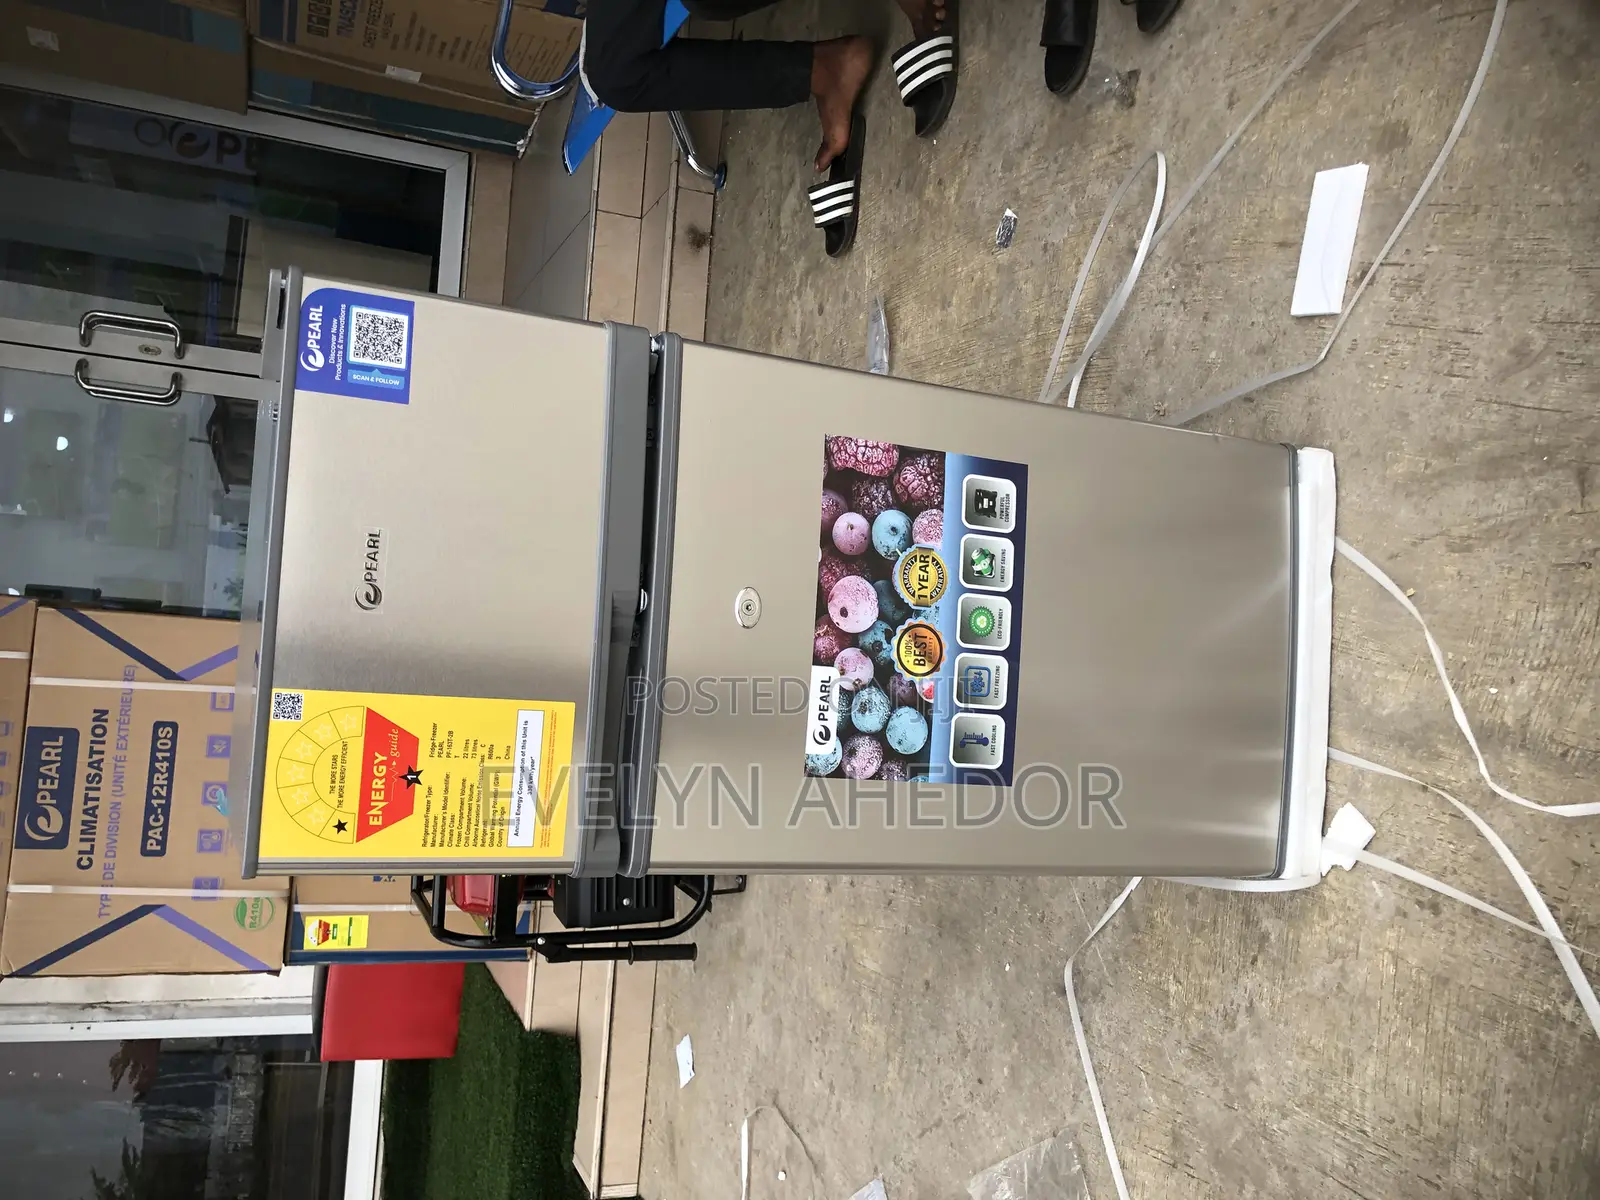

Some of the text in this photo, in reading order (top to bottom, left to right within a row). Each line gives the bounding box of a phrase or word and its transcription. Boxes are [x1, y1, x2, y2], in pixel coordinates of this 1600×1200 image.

[307, 305, 323, 349] PEARL
[328, 317, 338, 364] Discover New
[337, 303, 346, 344] Innovations
[334, 350, 343, 381] Products
[352, 374, 370, 382] SCAN
[375, 377, 400, 386] FOLLOW
[362, 529, 381, 583] PEARL
[918, 554, 930, 591] YEAR
[903, 557, 916, 594] WARRANTY
[931, 559, 944, 598] WARRANTY
[904, 639, 913, 658] 100%
[913, 632, 928, 667] BEST
[817, 675, 832, 722] PEARL
[331, 754, 339, 770] STARS
[388, 729, 400, 758] guide
[35, 735, 64, 805] PEARL
[111, 754, 127, 798] (UNITÉ
[146, 726, 173, 851] PAC-12R410S
[336, 741, 348, 808] THE MORE ENERGY EFFICIENT
[421, 722, 438, 848] Refrigerator/Freezer Type: Fridge-Freezer
[443, 771, 451, 795] Identifier:
[518, 757, 526, 795] Consumption
[76, 708, 110, 870] CLIMATISATION
[366, 752, 389, 826] ENERGY
[515, 796, 524, 816] Energy
[104, 801, 121, 859] DIVISION
[430, 814, 439, 848] Manufacturer:
[456, 797, 466, 830] Compartment
[465, 803, 474, 835] Compartment
[513, 817, 521, 837] Annual
[496, 828, 504, 847] Country
[102, 862, 115, 880] DE
